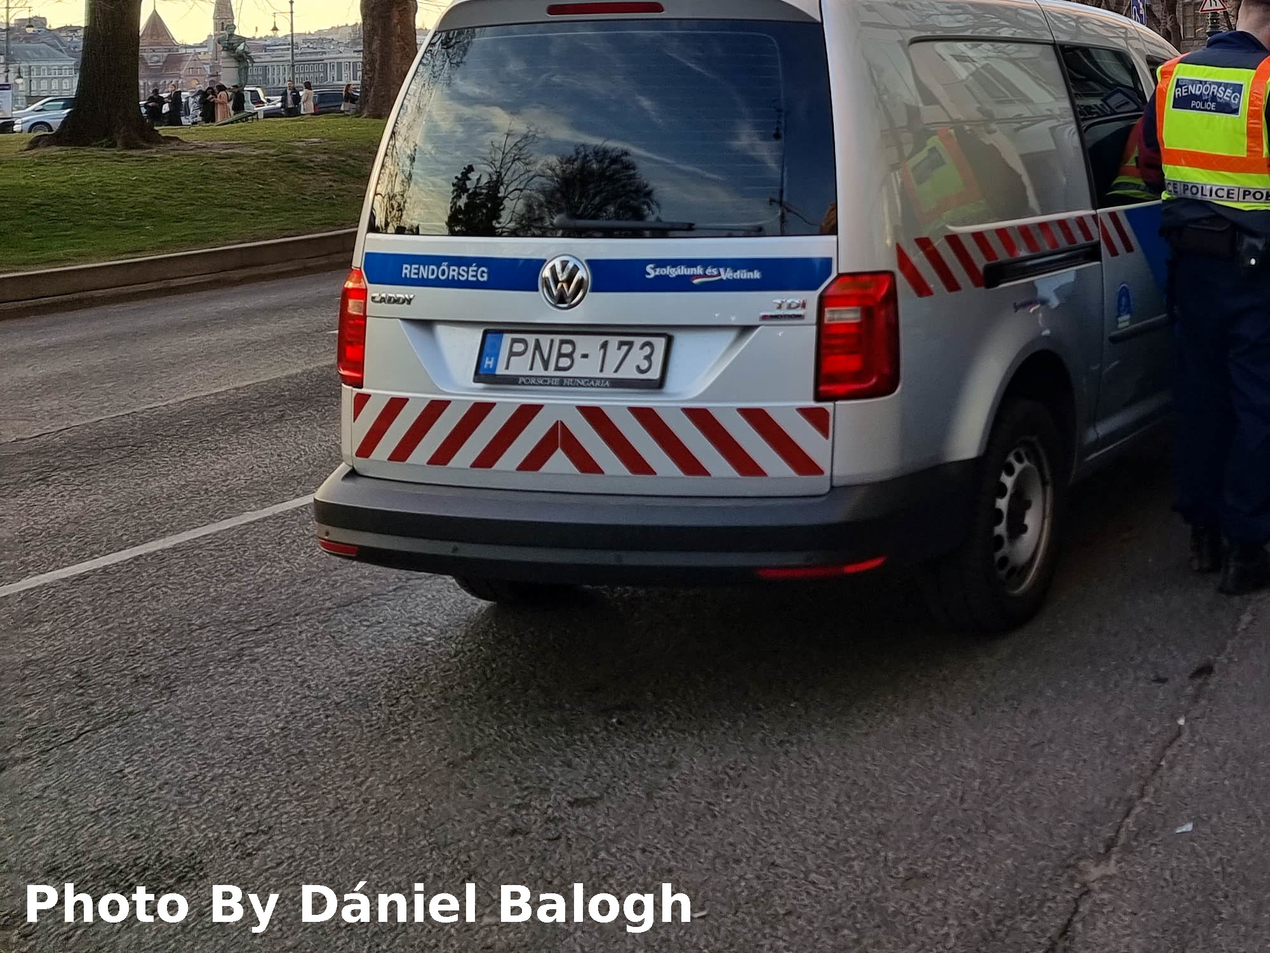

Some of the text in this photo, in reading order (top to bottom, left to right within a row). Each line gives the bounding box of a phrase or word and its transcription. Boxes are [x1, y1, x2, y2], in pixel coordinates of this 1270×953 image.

[1190, 100, 1217, 110] POLICE
[1182, 182, 1235, 200] POLICE
[401, 261, 488, 282] RENDŐRSÉG
[645, 263, 703, 279] Szolgálunk
[705, 265, 718, 276] és
[370, 292, 415, 305] CADDY
[772, 298, 807, 310] TDI
[484, 337, 655, 375] H PNB-173
[518, 376, 610, 387] PORSCHE HUNGARIA
